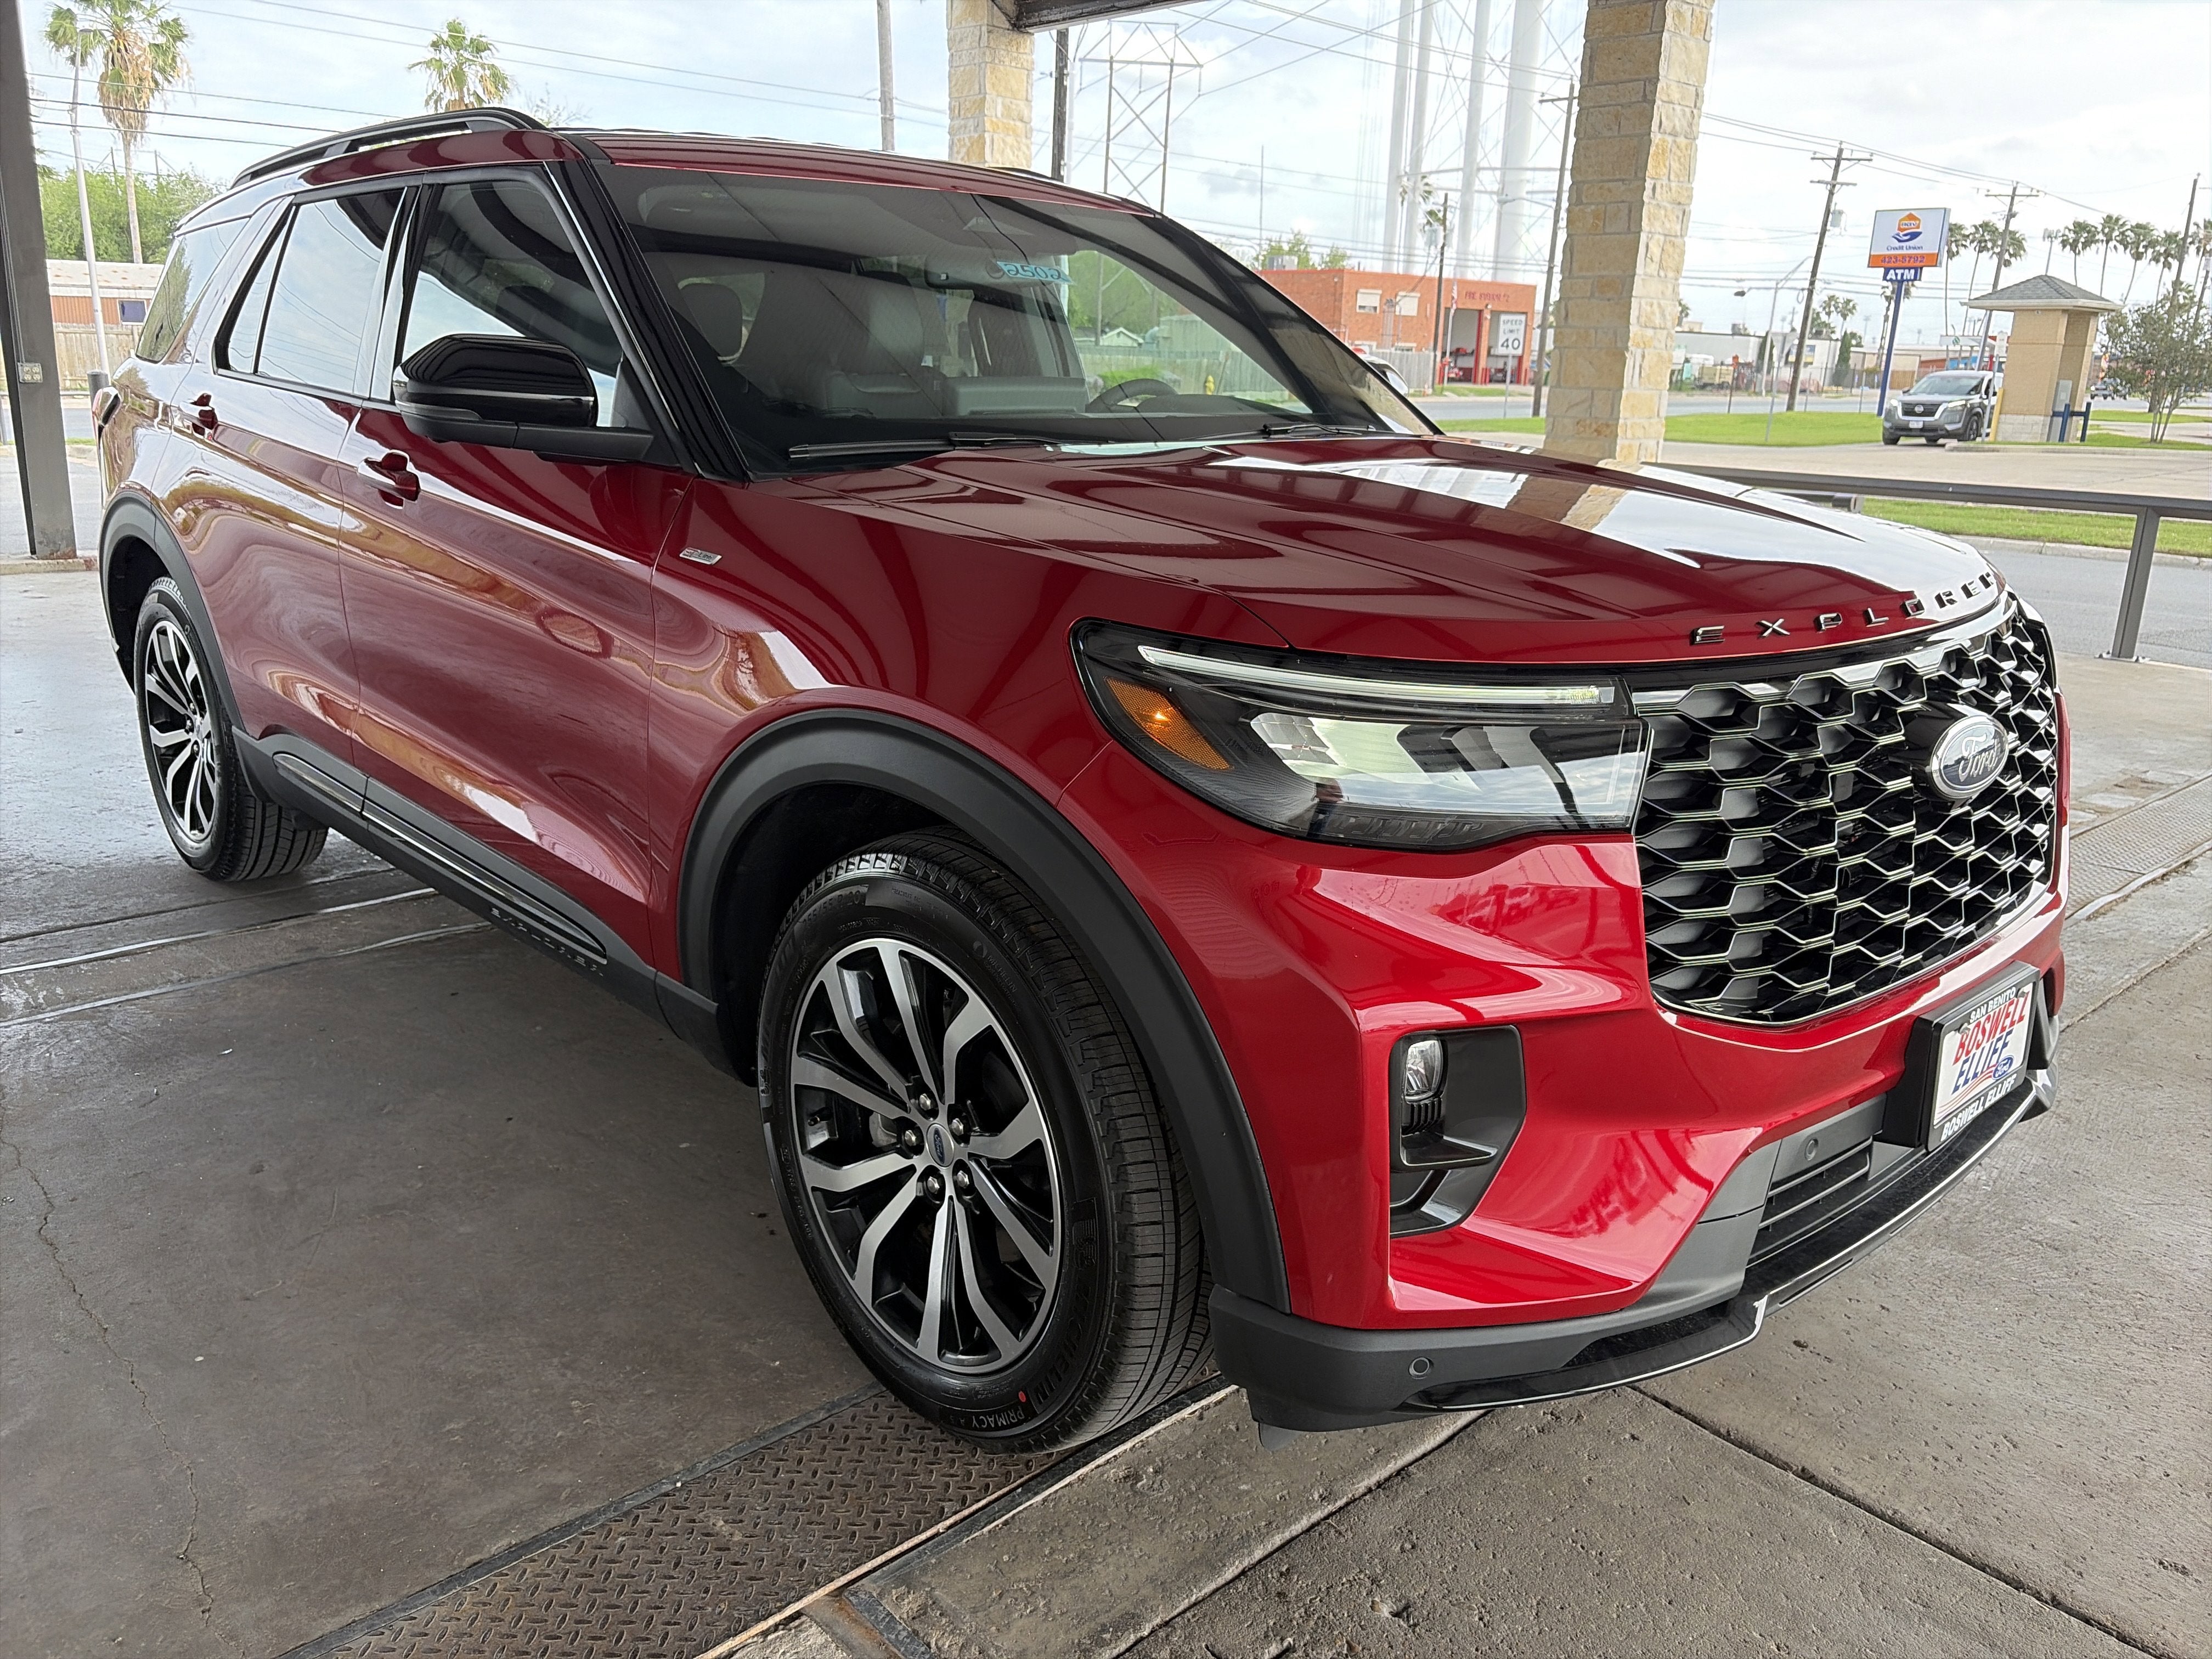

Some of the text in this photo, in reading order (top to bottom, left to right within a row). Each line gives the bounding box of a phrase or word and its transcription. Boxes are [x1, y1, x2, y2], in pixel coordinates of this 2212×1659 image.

[1004, 263, 1070, 282] 2502
[1886, 269, 1915, 280] ATM
[1500, 338, 1521, 350] 40
[1690, 571, 1996, 645] EXPLORER
[1958, 732, 1998, 782] Ford
[1970, 986, 2016, 1024] SAN BENITO
[1953, 992, 2030, 1066] BOSWELL
[1951, 1029, 2013, 1096] ELLIFF
[1940, 1073, 2017, 1143] BOSWELL ELLIFF
[972, 1405, 1025, 1428] PRIMACY
